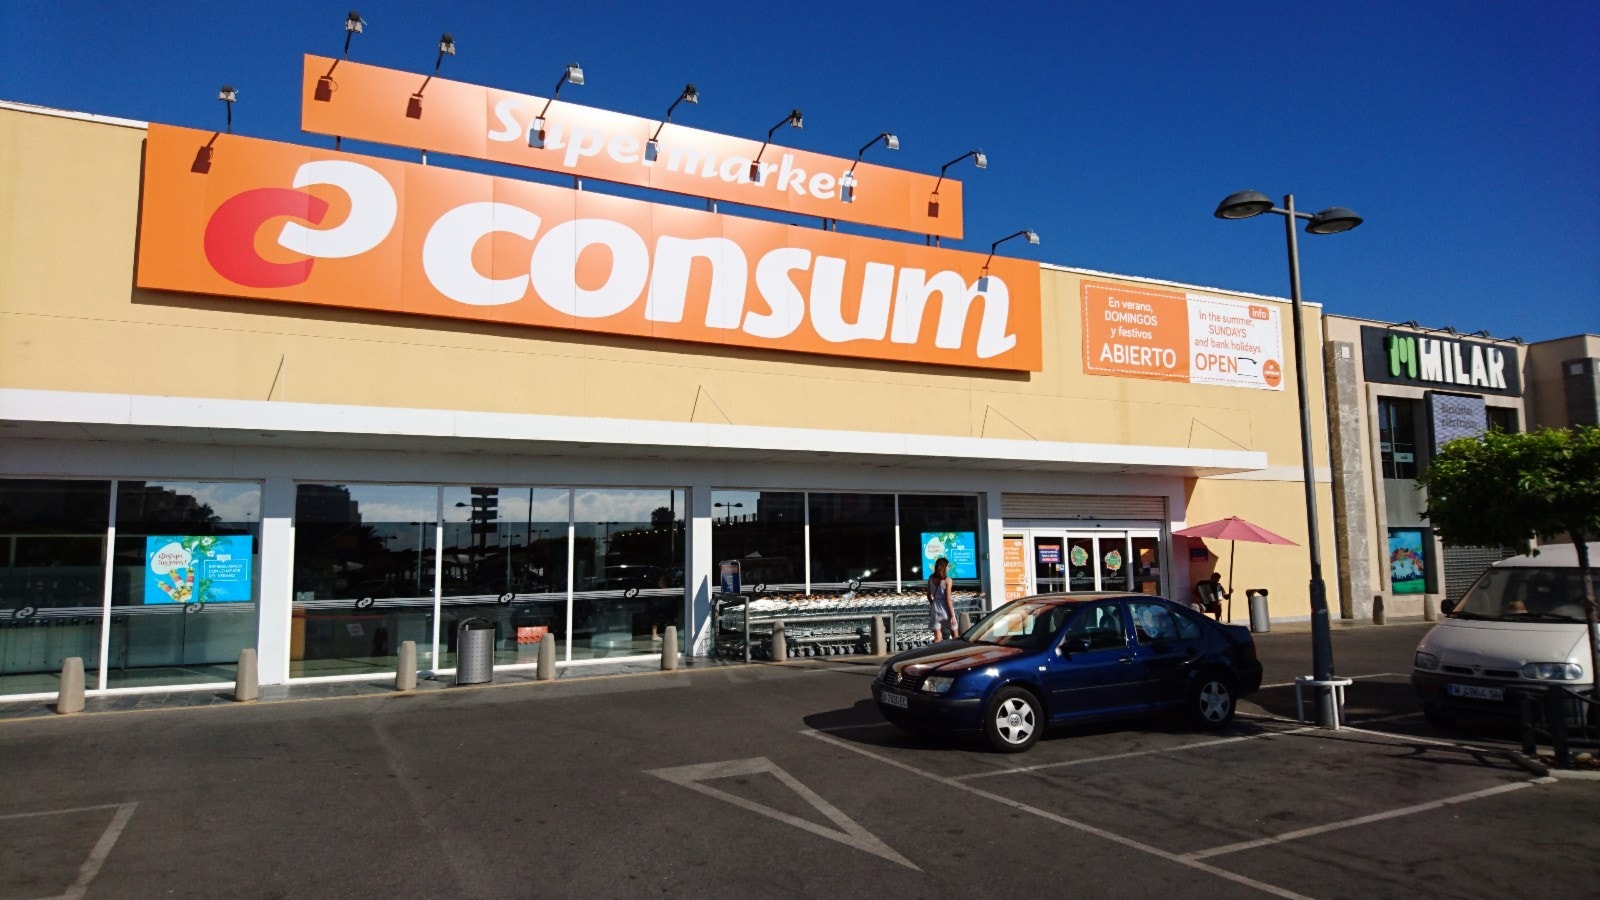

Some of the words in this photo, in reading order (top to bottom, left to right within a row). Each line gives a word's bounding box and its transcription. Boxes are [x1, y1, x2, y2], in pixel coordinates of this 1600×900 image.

[487, 99, 858, 201] Supermarket
[422, 201, 1017, 359] consum
[1108, 296, 1120, 308] En
[1122, 300, 1153, 313] verano,
[1252, 307, 1267, 319] info
[1104, 310, 1157, 326] DOMINGOS
[1198, 310, 1207, 320] In
[1208, 311, 1220, 322] the
[1222, 315, 1255, 328] summer,
[1110, 327, 1117, 338] y
[1118, 325, 1152, 340] festivos
[1209, 324, 1247, 339] SUNDAYS
[1194, 337, 1209, 348] and
[1211, 337, 1229, 350] bank
[1231, 340, 1262, 355] holidays
[1100, 342, 1176, 369] ABIERTO
[1195, 352, 1238, 374] OPEN
[1418, 337, 1507, 389] MILAR
